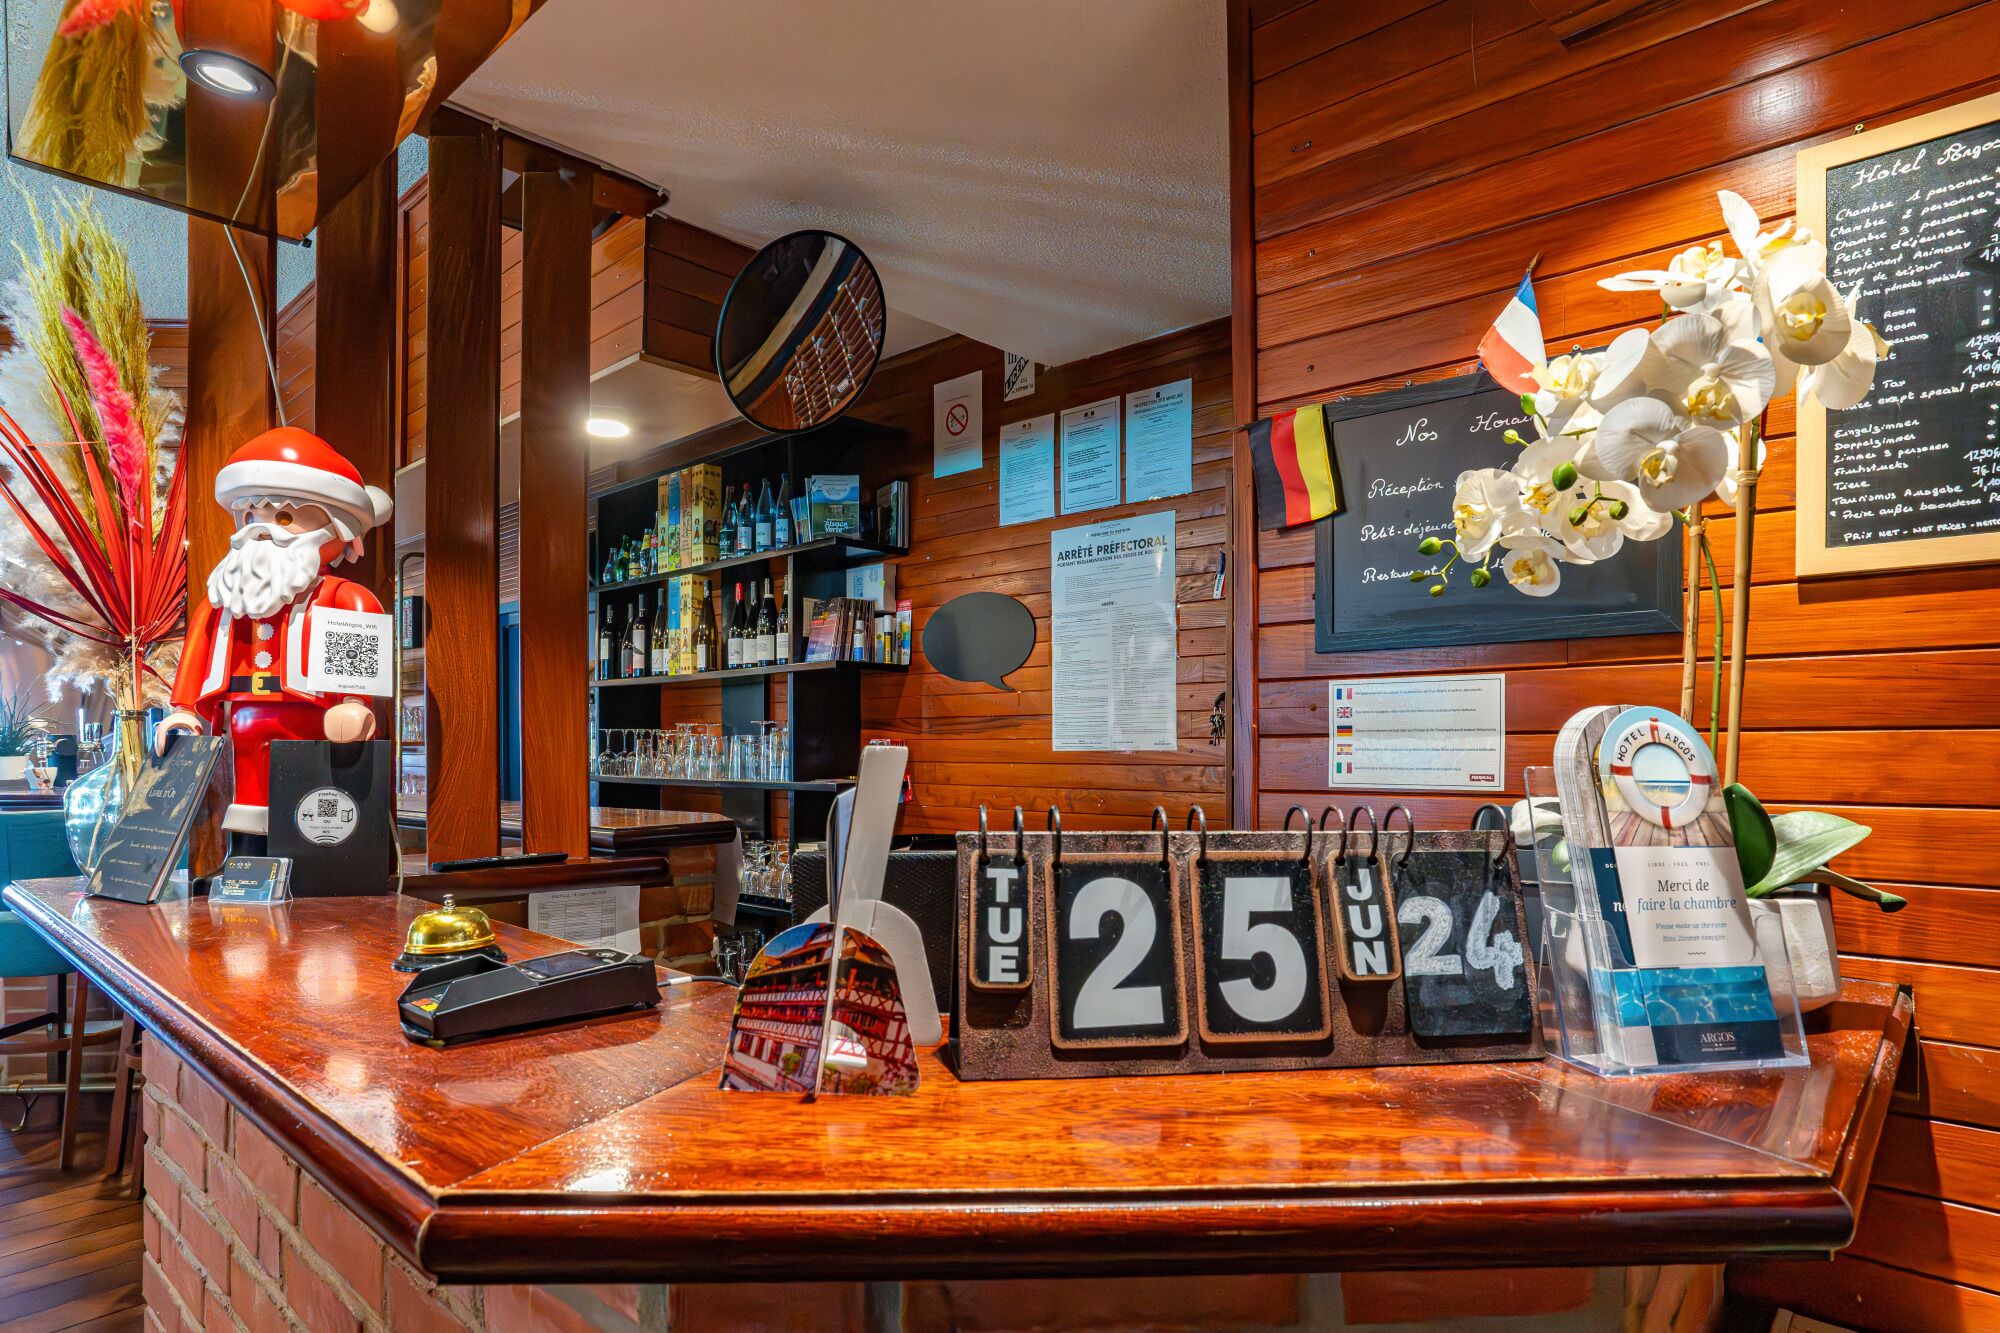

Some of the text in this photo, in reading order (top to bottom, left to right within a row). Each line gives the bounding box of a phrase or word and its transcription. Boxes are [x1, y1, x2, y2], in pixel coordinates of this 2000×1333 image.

[1850, 148, 1926, 189] Hotel
[1836, 201, 1894, 221] Chambre
[1830, 218, 1888, 237] Chambre
[1902, 209, 1913, 219] 2
[1834, 231, 1888, 251] Chambre
[1899, 225, 1910, 236] 3
[1872, 271, 1888, 282] de
[1883, 308, 1917, 319] Room
[1885, 320, 1917, 332] Room
[1882, 380, 1906, 389] Tax
[1396, 418, 1438, 446] Nos
[1368, 478, 1444, 499] Réception
[1058, 544, 1093, 561] ARRÊTÉ
[1096, 534, 1168, 556] PRÉFECTORAL
[1617, 728, 1696, 762] HOTEL ARGOS
[1657, 878, 1710, 892] Merci de
[1637, 896, 1737, 914] faire la chambre
[987, 869, 1018, 982] TUE
[1346, 869, 1387, 976] JUN
[1397, 890, 1523, 990] 24
[1700, 1032, 1735, 1043] ARGOS
